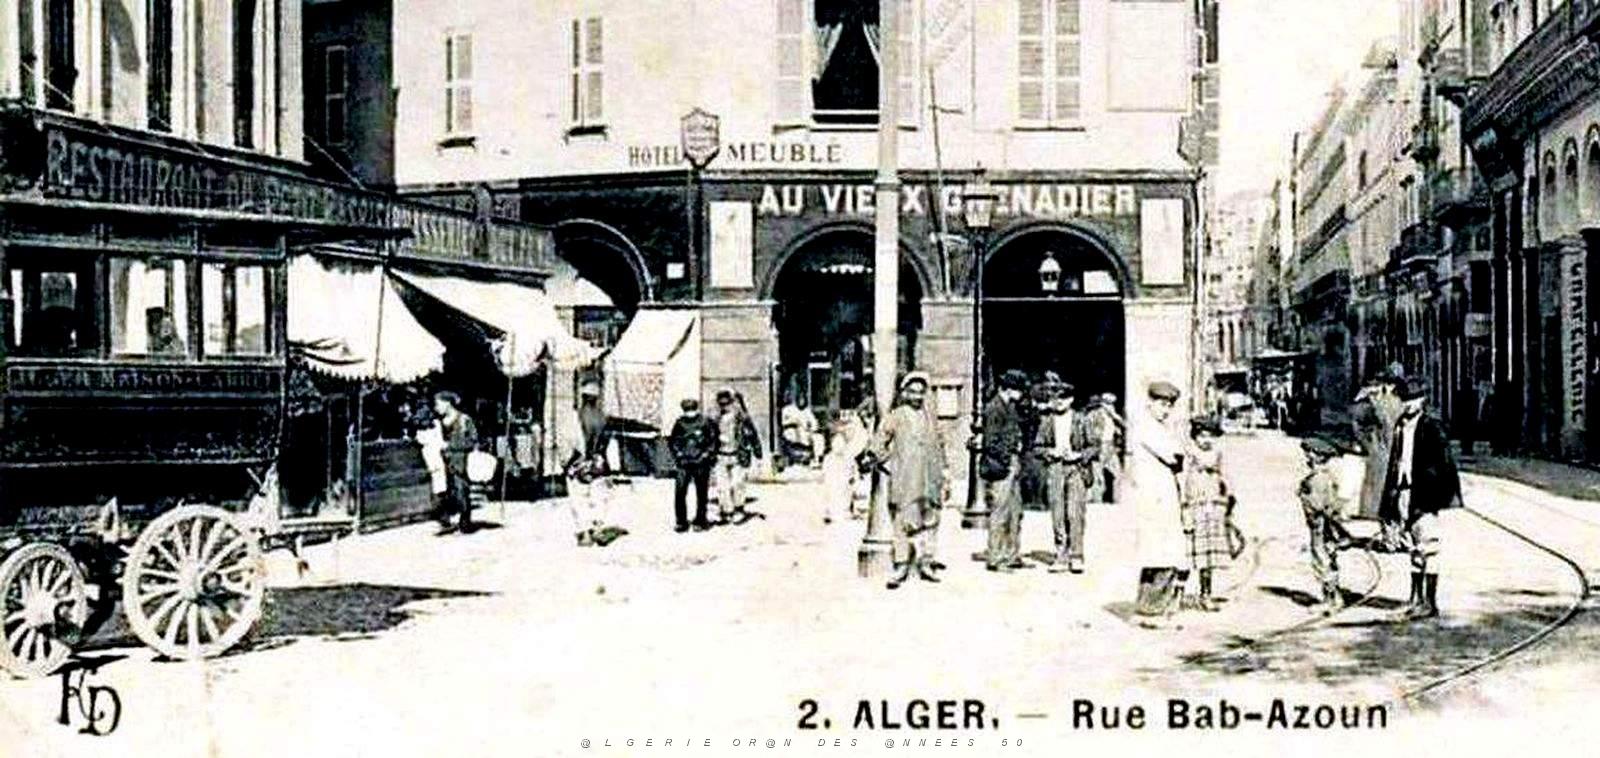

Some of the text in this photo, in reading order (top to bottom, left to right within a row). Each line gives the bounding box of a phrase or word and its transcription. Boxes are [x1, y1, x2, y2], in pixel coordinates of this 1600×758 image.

[46, 129, 218, 209] RESTAURANT
[758, 184, 1137, 216] AU VIEX GENADIER
